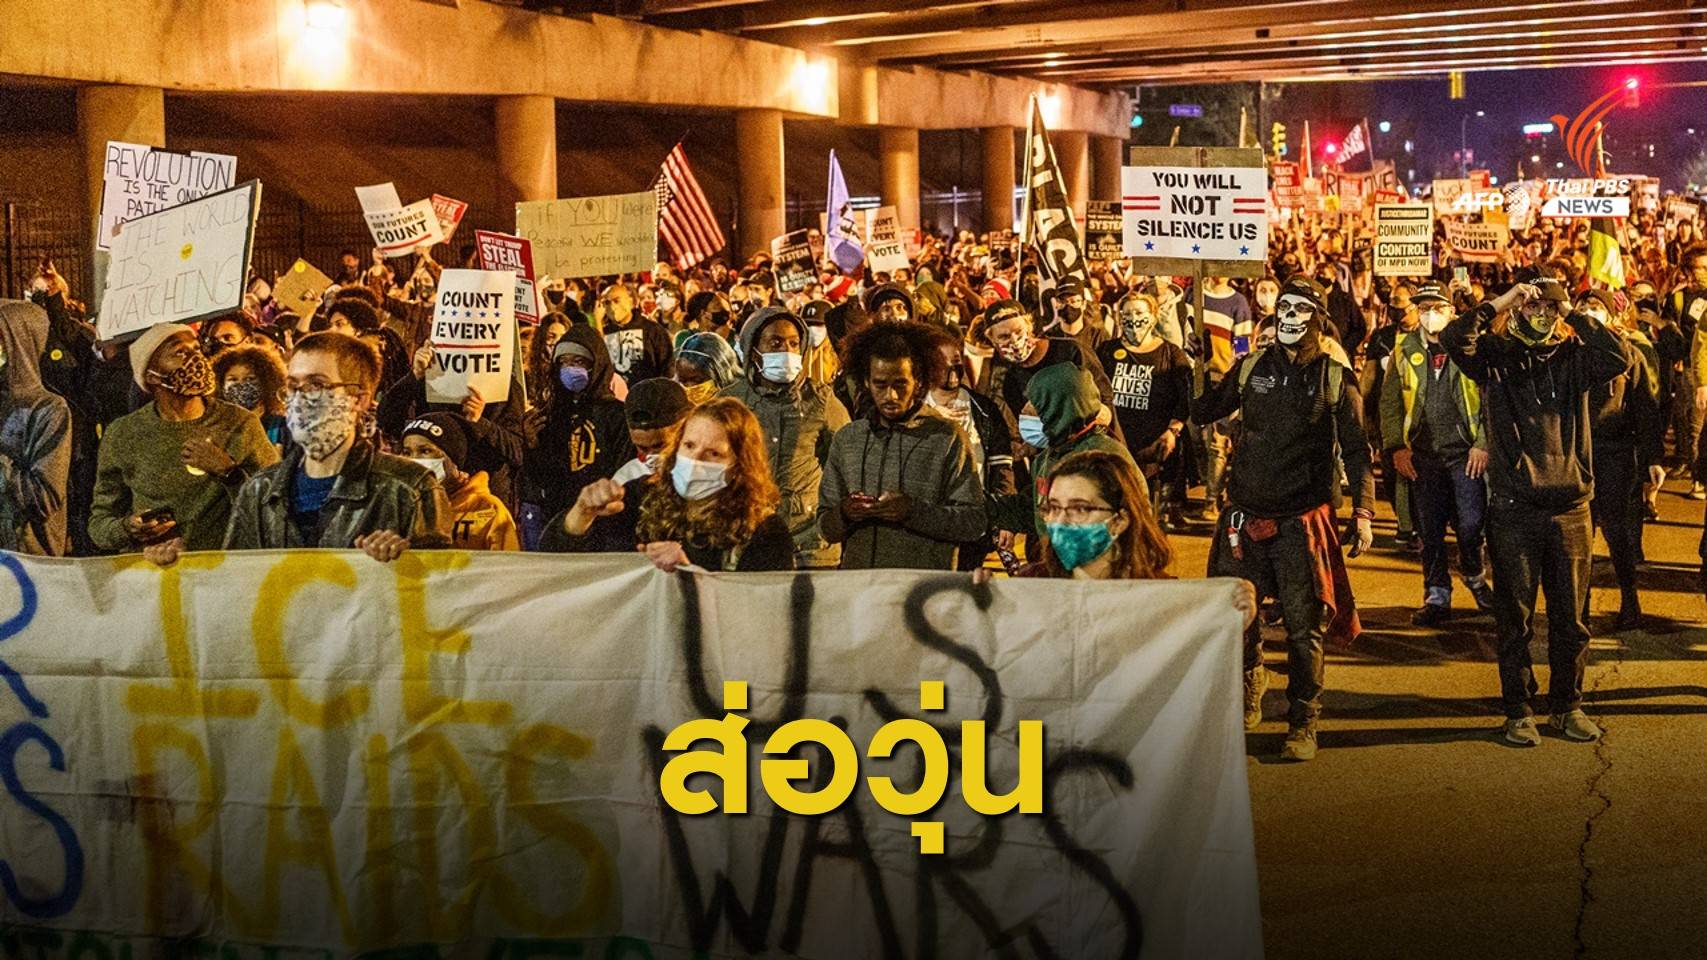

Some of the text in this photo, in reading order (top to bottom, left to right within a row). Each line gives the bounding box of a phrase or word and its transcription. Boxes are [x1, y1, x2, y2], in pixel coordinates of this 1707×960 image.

[107, 146, 232, 190] REVOLUTION
[1152, 172, 1241, 190] YOU WILL
[123, 180, 209, 204] IS THE ONLY
[567, 198, 618, 227] YOU
[1171, 194, 1221, 216] NOT
[120, 193, 250, 258] THE WORLD
[387, 211, 425, 227] FUTURES
[1088, 220, 1122, 230] SYSTE
[376, 220, 427, 243] COUNT
[1137, 219, 1257, 240] SILENCE US
[1378, 224, 1429, 236] COMMUNITY
[580, 232, 614, 248] WE
[1380, 244, 1427, 256] CONTROL
[1452, 235, 1499, 251] COUNT
[482, 243, 525, 269] STEAL
[872, 244, 900, 257] VOTE
[114, 250, 152, 292] IS
[108, 253, 240, 330] WATCHING
[441, 291, 503, 308] COUNT
[436, 322, 501, 339] EVERY
[435, 353, 501, 373] VOTE
[1114, 362, 1155, 380] BLACK
[1112, 376, 1151, 396] LIVES
[112, 550, 512, 728] ICE
[133, 721, 619, 950] RAIDS
